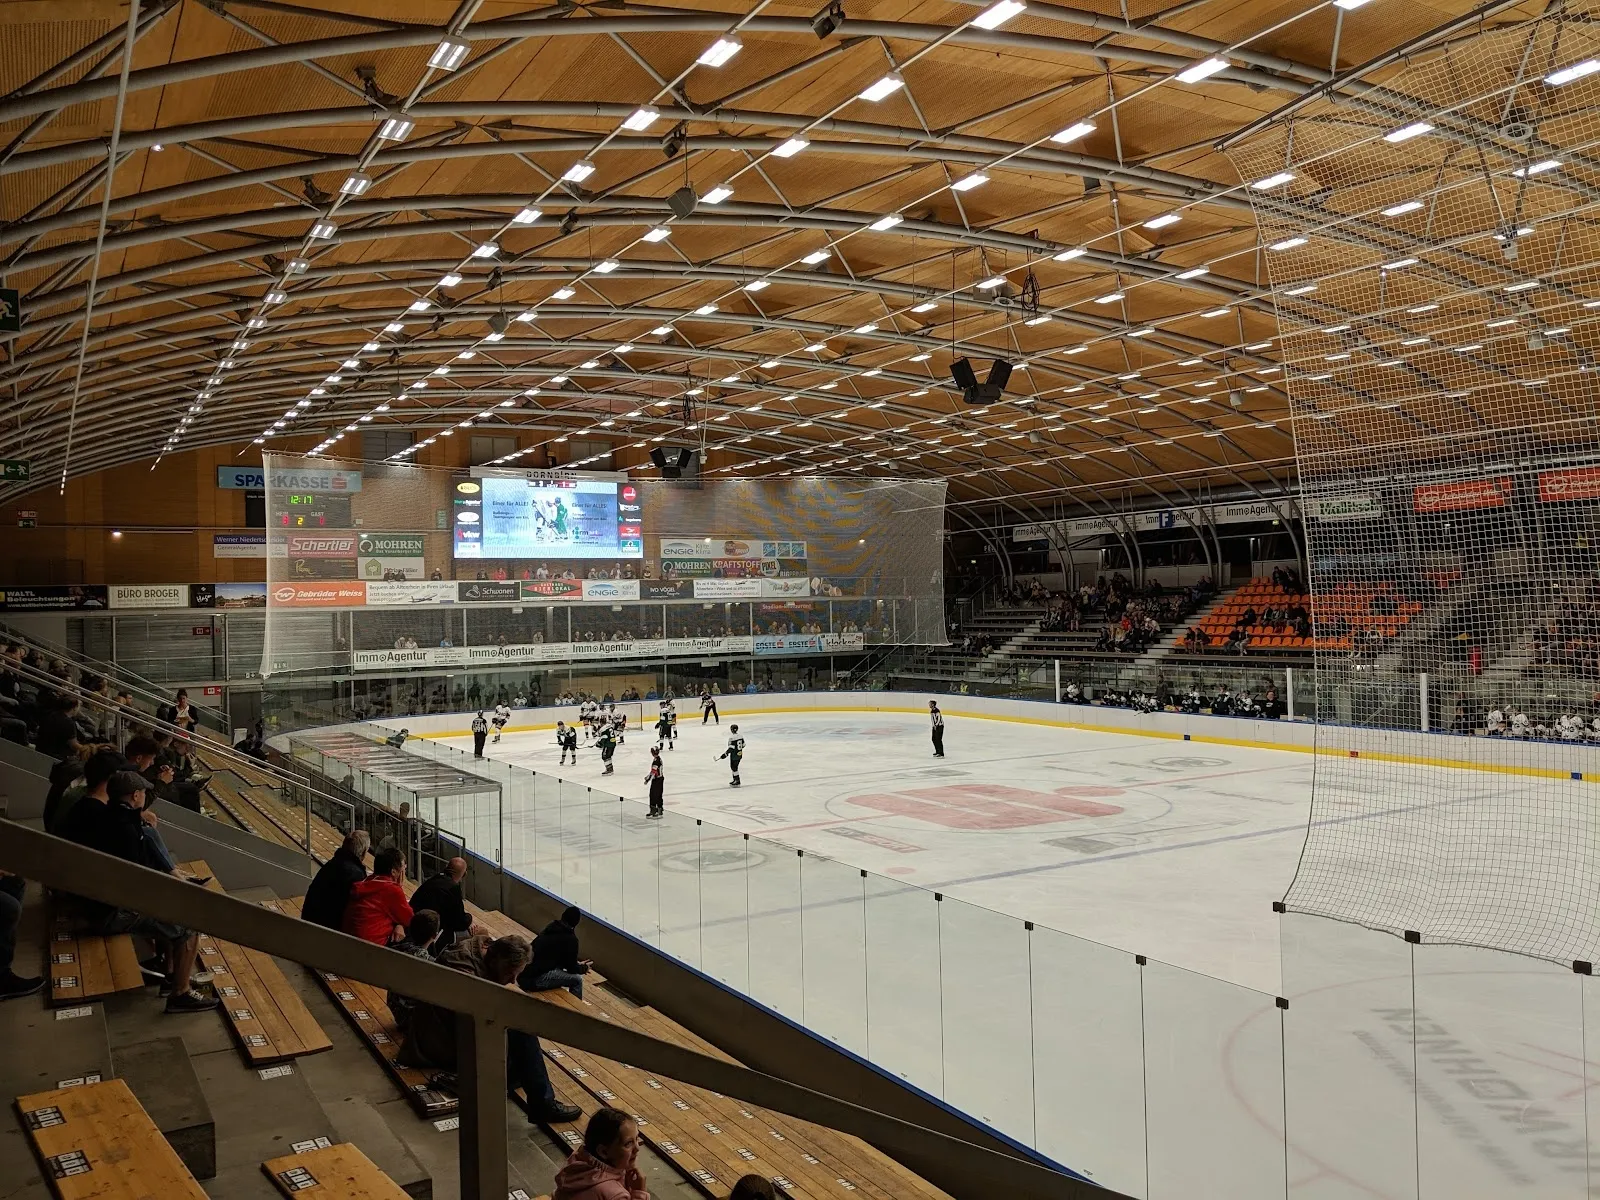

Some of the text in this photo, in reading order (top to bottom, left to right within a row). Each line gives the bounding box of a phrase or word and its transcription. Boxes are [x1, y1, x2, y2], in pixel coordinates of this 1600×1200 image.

[1226, 504, 1282, 516] ImmoAgenur
[1075, 520, 1118, 530] ImmoAgenur
[290, 538, 354, 550] Schertler
[375, 540, 422, 549] MOHREN
[675, 561, 711, 570] MOHREN
[712, 560, 760, 568] KRAFTSTOFF
[117, 588, 179, 599] BÜRO BROGER
[355, 651, 428, 664] ImmoAgentur
